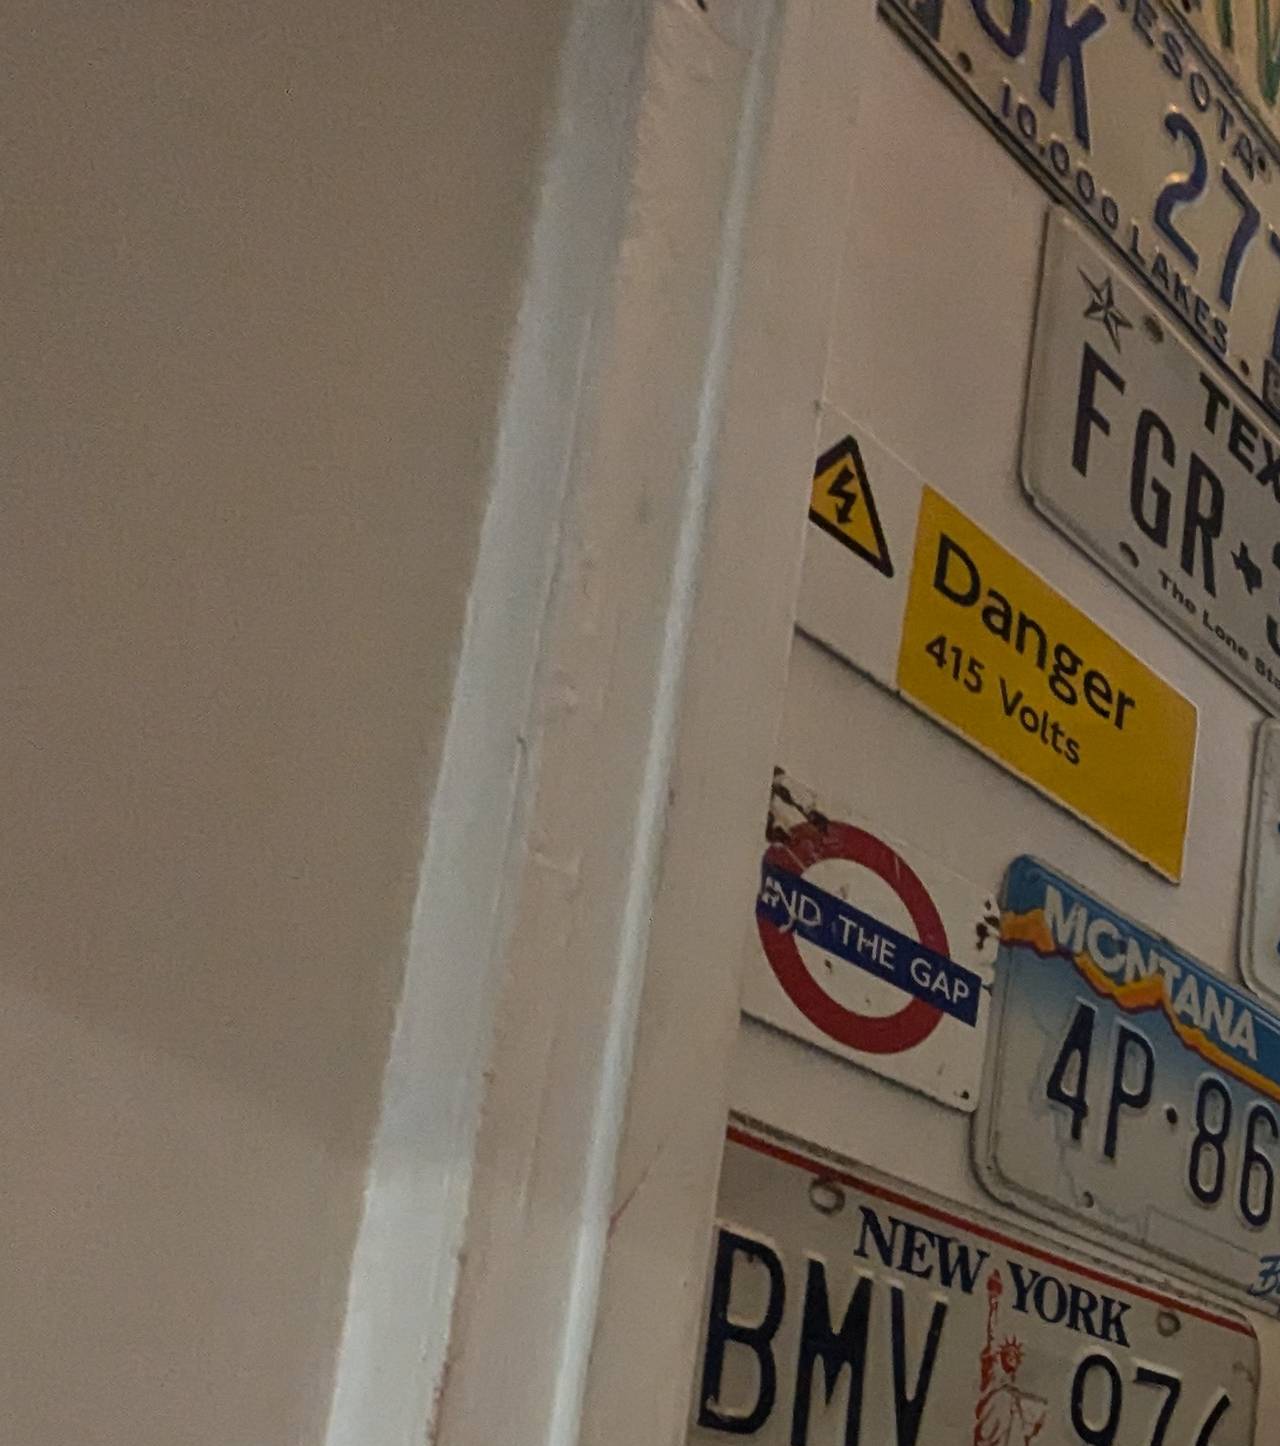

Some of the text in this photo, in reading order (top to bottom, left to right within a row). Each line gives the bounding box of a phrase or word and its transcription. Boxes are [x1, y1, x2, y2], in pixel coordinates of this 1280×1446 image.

[1130, 225, 1226, 344] LAKES
[935, 536, 1133, 726] Danger
[1158, 569, 1196, 613] The
[1202, 609, 1248, 660] Lone
[925, 635, 1078, 763] 415 Volts
[838, 914, 897, 971] THE
[910, 957, 972, 1006] GAP
[1045, 888, 1255, 1056] MONTANA
[853, 1205, 1132, 1349] NEW YORK
